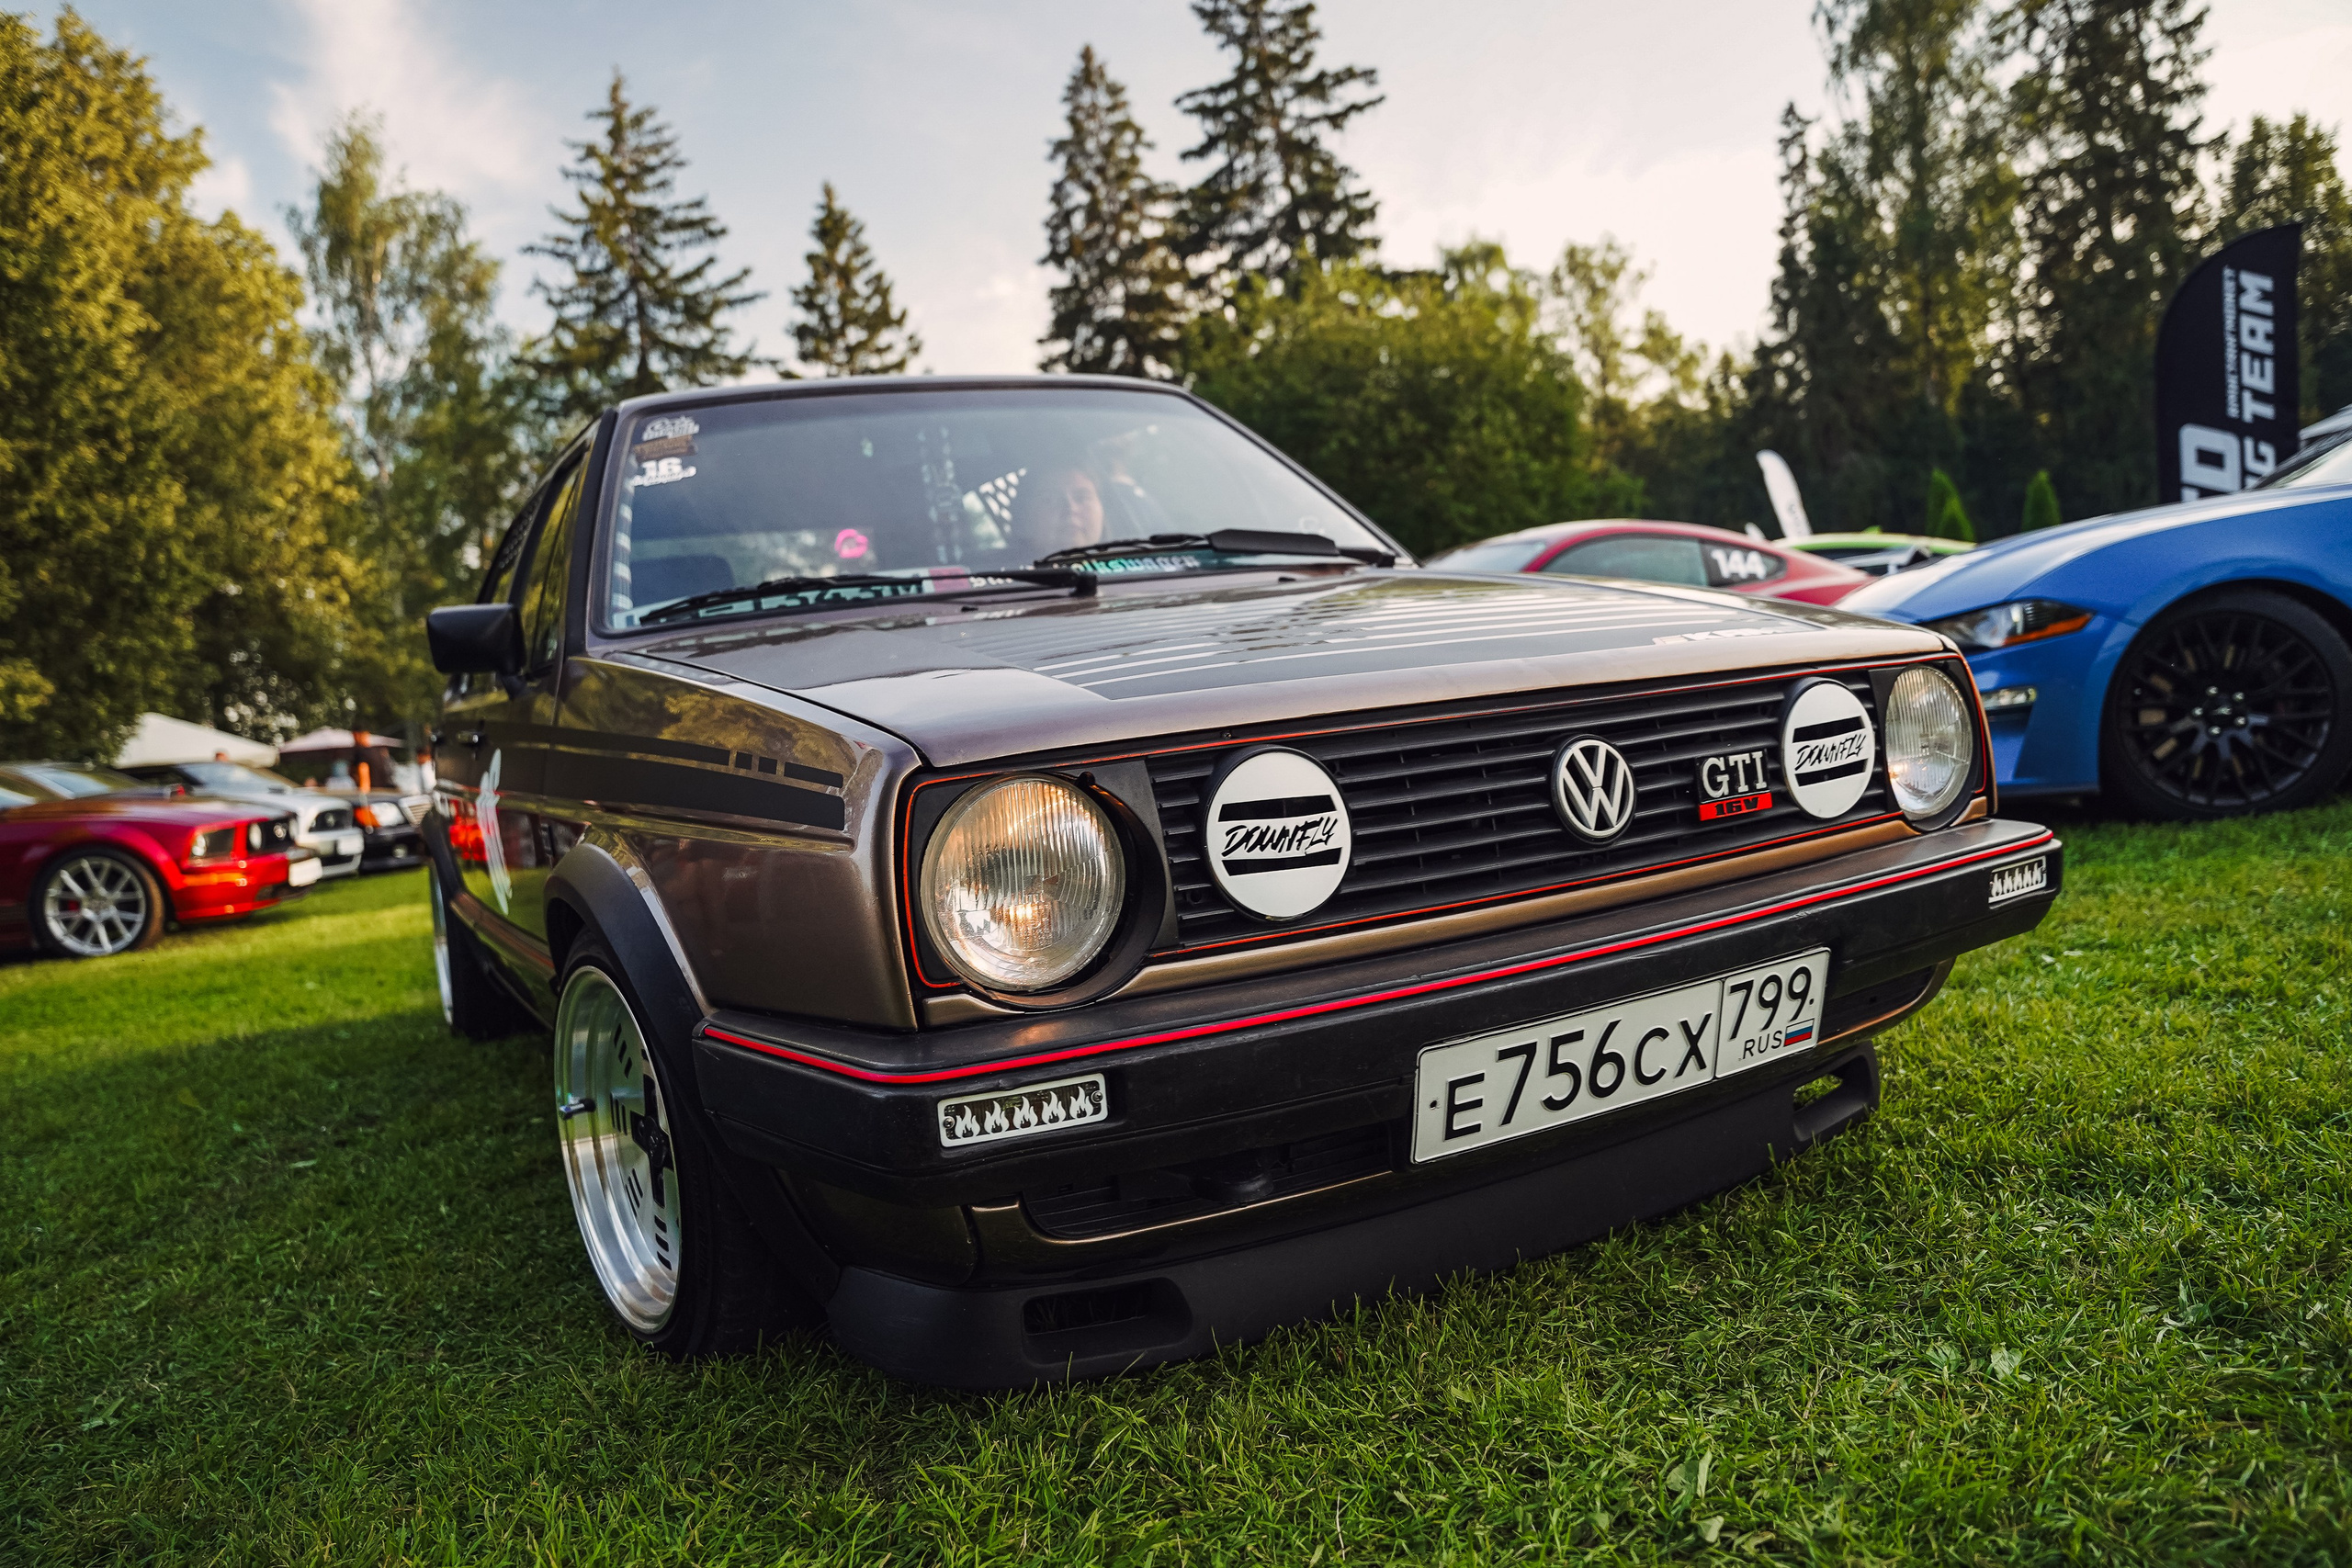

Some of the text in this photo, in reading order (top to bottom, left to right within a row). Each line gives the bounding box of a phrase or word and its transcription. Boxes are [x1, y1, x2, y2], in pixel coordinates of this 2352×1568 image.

[2238, 269, 2276, 423] TEAM
[1053, 556, 1201, 573] olkswagen
[1712, 550, 1765, 580] 144
[1794, 734, 1866, 771] DOWNFLY
[1562, 740, 1633, 837] VW
[1702, 750, 1768, 798] GTI
[1714, 796, 1759, 816] 16V
[1221, 817, 1338, 857] DOWNFLY
[1728, 966, 1812, 1041] 799
[1743, 1038, 1782, 1060] RUS
